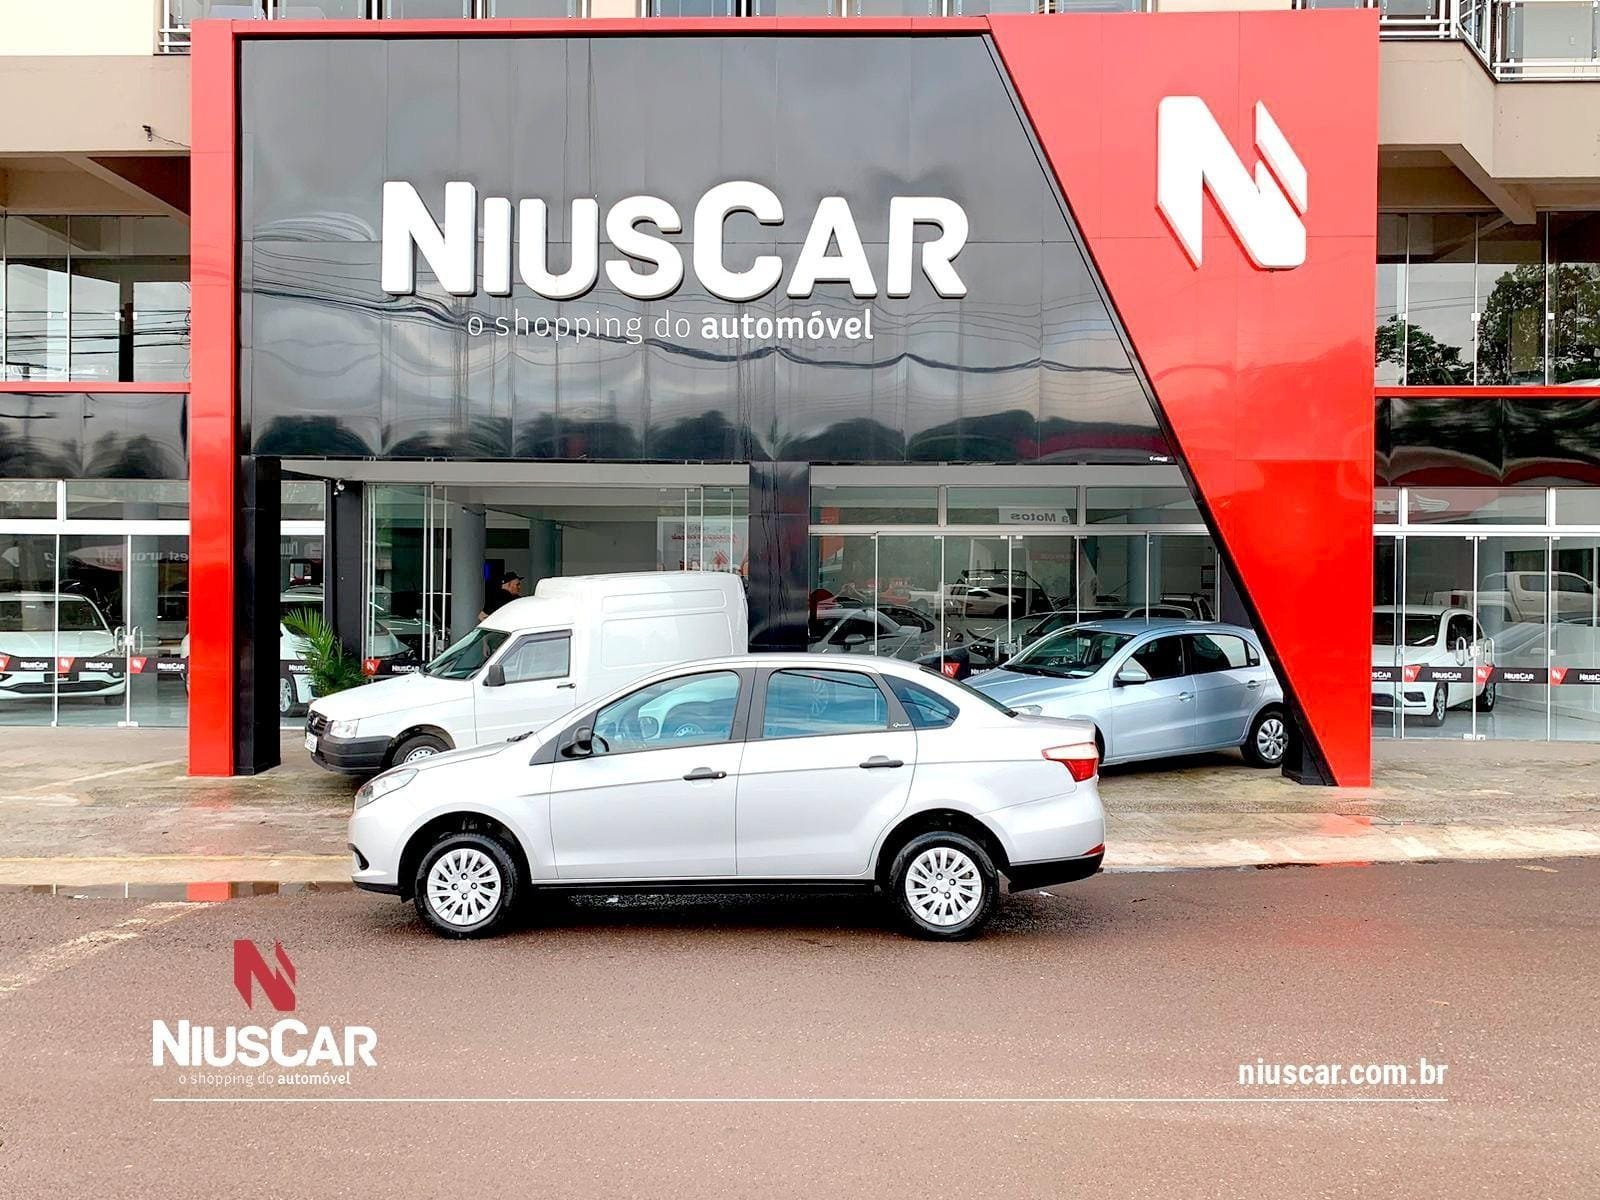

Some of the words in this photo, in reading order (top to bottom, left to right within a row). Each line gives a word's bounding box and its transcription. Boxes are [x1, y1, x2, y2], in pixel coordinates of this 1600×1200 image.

[468, 315, 483, 336] o
[495, 308, 643, 345] shopping
[654, 309, 691, 338] do
[701, 308, 874, 340] automóvel
